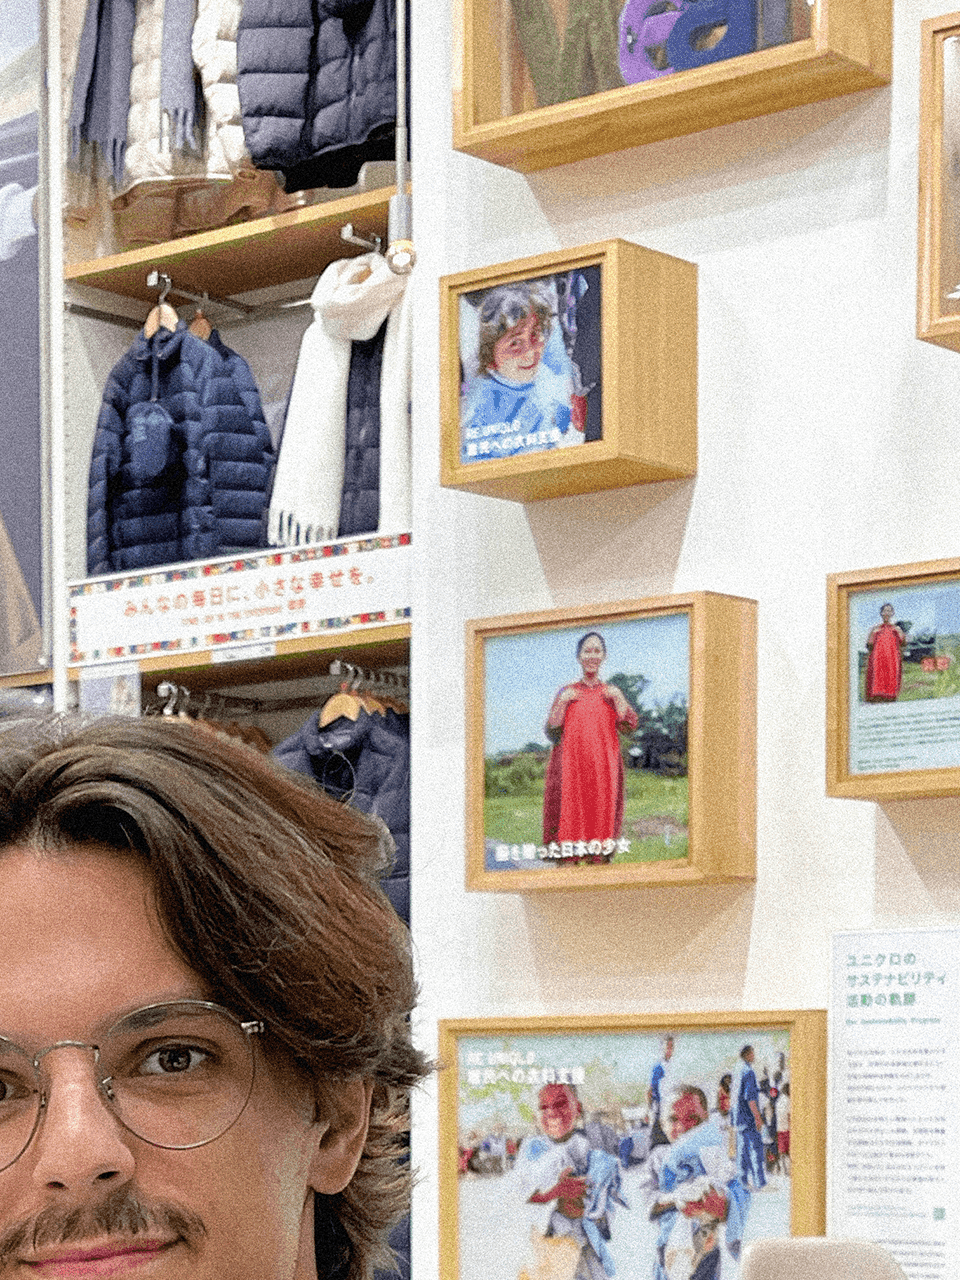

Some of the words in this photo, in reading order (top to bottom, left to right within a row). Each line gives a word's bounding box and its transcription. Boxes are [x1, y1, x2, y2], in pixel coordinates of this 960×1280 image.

[846, 952, 917, 967] ユニクロの
[847, 971, 947, 988] サステナビリティ
